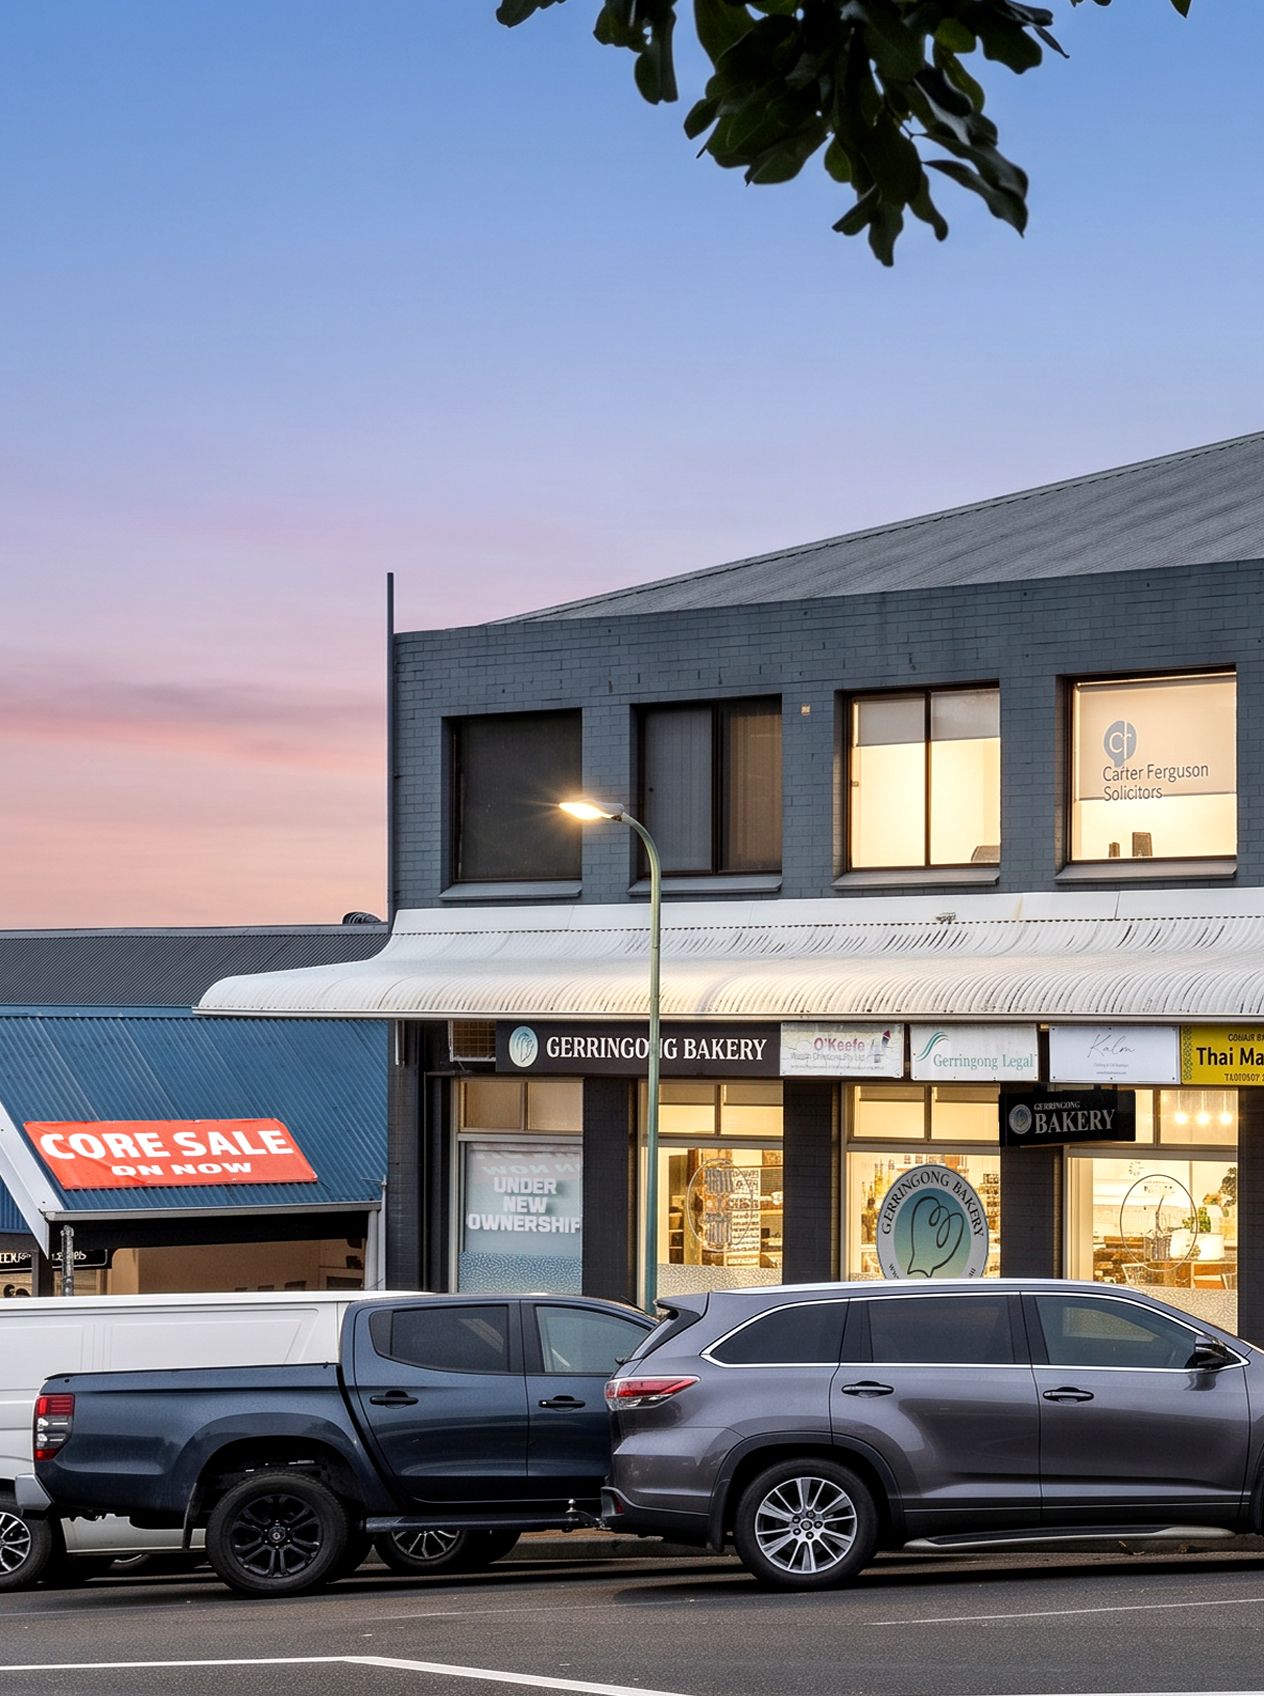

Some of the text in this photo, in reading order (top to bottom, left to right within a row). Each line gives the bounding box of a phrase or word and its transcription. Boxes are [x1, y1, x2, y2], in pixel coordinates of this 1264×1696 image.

[1103, 764, 1209, 783] Carter Ferguson
[1103, 785, 1164, 802] Solicitors
[546, 1036, 767, 1061] GERRINGOG BAKERY
[1196, 1047, 1234, 1066] Thai
[933, 1053, 1033, 1071] Gerringong Legal
[1033, 1101, 1080, 1111] GERRINGONG
[1034, 1108, 1115, 1134] BAKERY
[40, 1129, 294, 1160] CORE SALE
[111, 1162, 252, 1177] ON NOW
[494, 1177, 557, 1194] UNDER
[503, 1196, 548, 1214] NEW
[881, 1170, 984, 1237] GERRINGONG BAKERY
